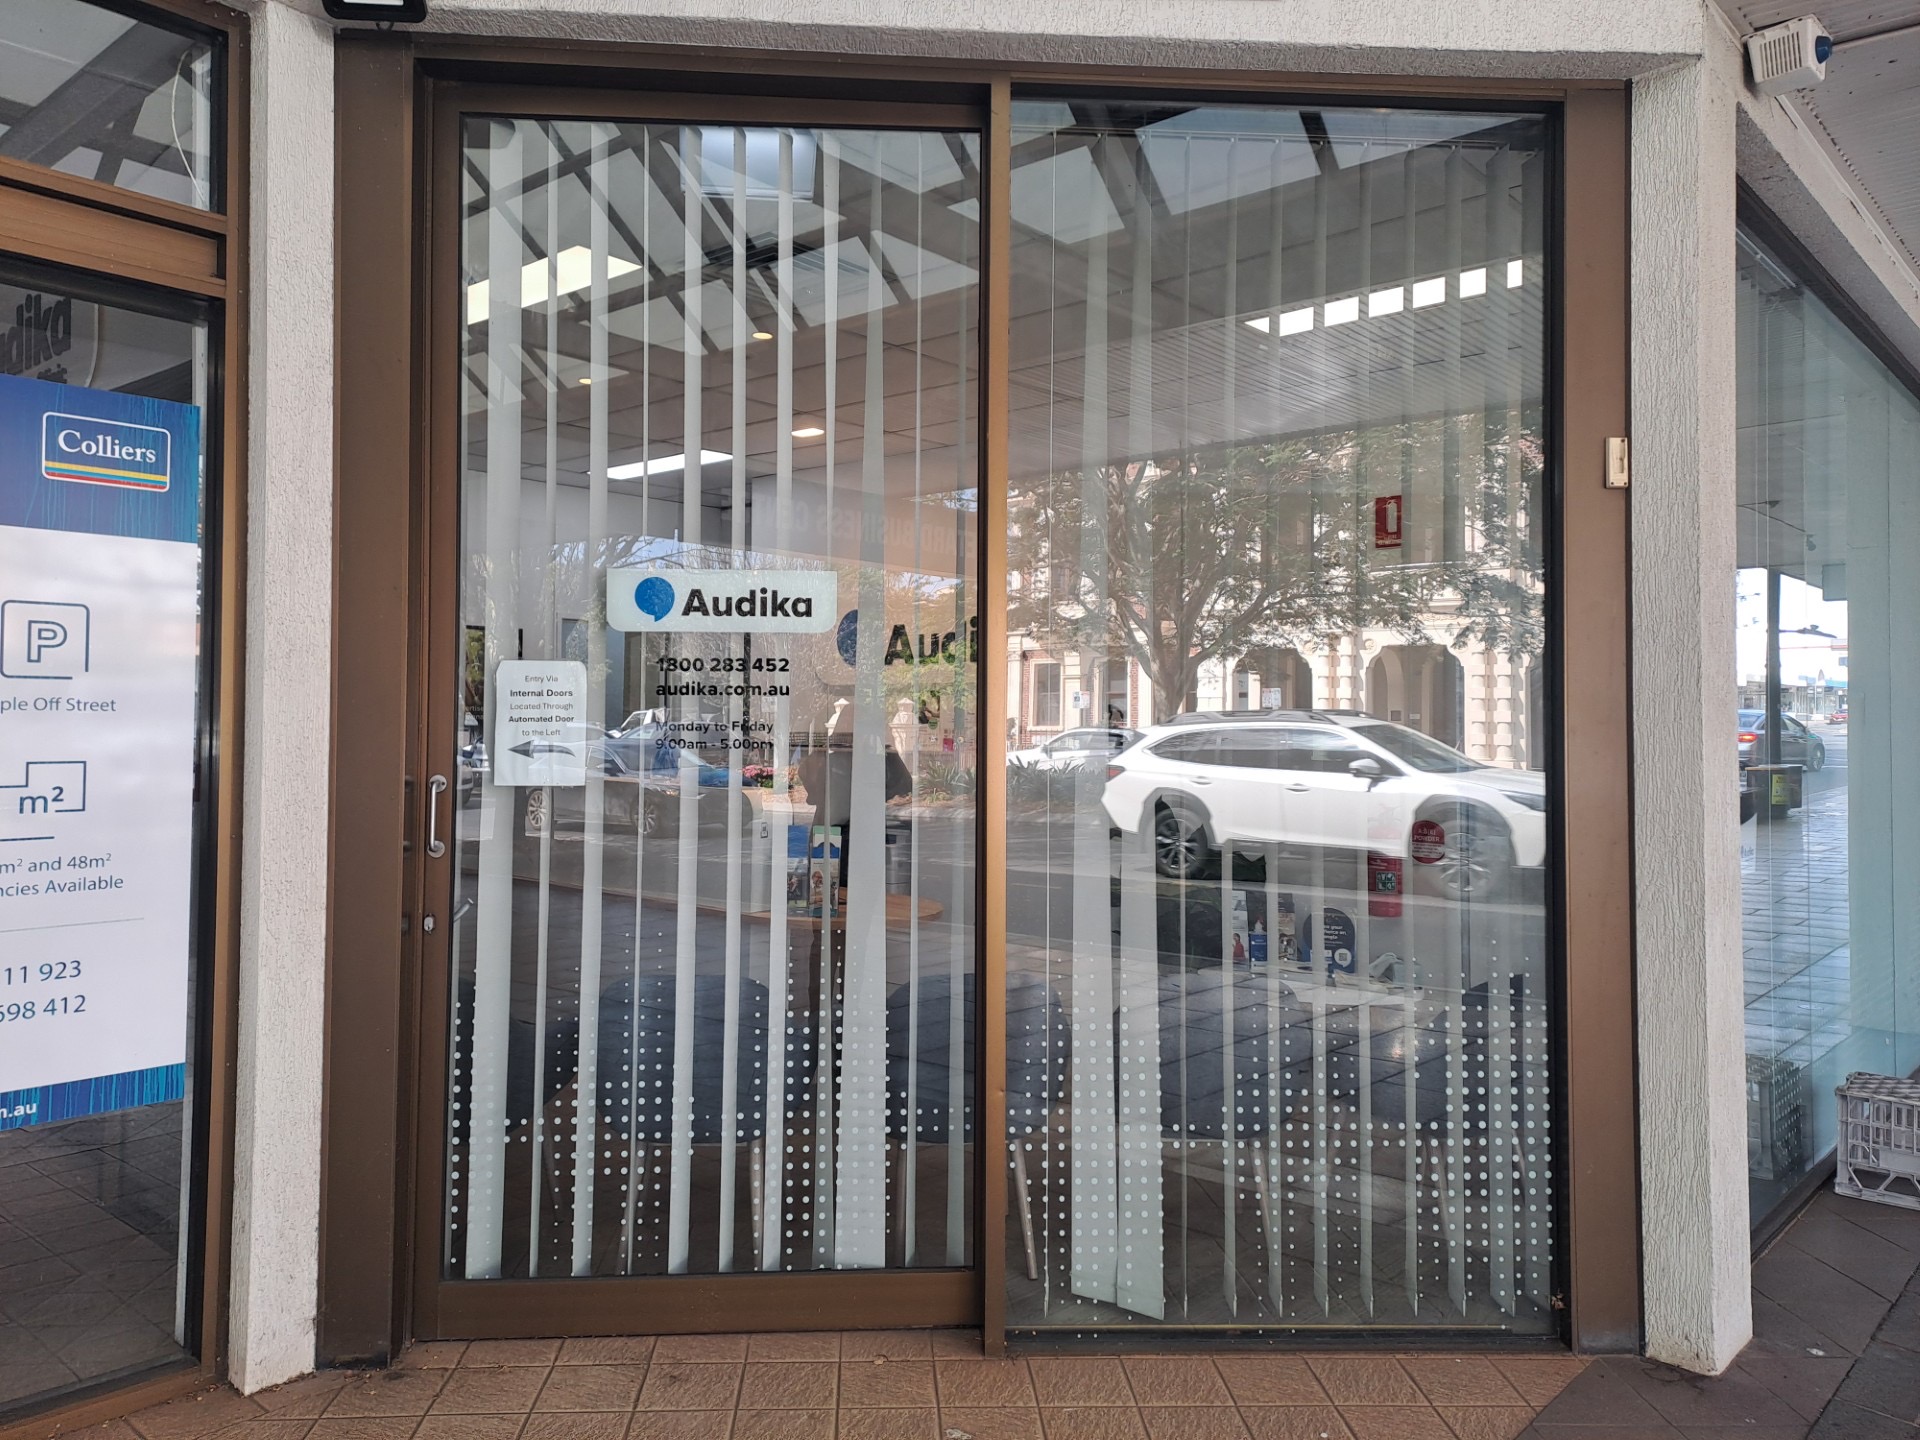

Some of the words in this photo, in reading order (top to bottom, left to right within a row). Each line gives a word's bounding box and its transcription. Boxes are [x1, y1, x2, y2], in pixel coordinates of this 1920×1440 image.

[0, 293, 71, 376] dika
[57, 429, 156, 464] Colliers
[681, 587, 813, 618] Audika
[656, 657, 705, 672] 1800
[709, 657, 745, 672] 283
[752, 657, 790, 672] 452
[524, 675, 544, 684] Entry
[510, 689, 544, 697] Internal
[546, 689, 573, 697] Doors
[655, 681, 790, 696] audika.com.au
[33, 697, 62, 712] Off
[65, 697, 117, 713] Street
[543, 702, 574, 711] Through
[508, 715, 553, 723] Automated
[555, 715, 575, 723] Door
[545, 728, 561, 736] Left
[655, 721, 711, 734] Monday
[714, 722, 728, 732] to
[731, 721, 774, 734] Friday
[655, 738, 708, 750] 9.00am
[720, 738, 774, 752] 5.00pm
[27, 857, 62, 873] and
[44, 875, 124, 895] Available
[38, 960, 82, 982] 923
[43, 995, 86, 1016] 412
